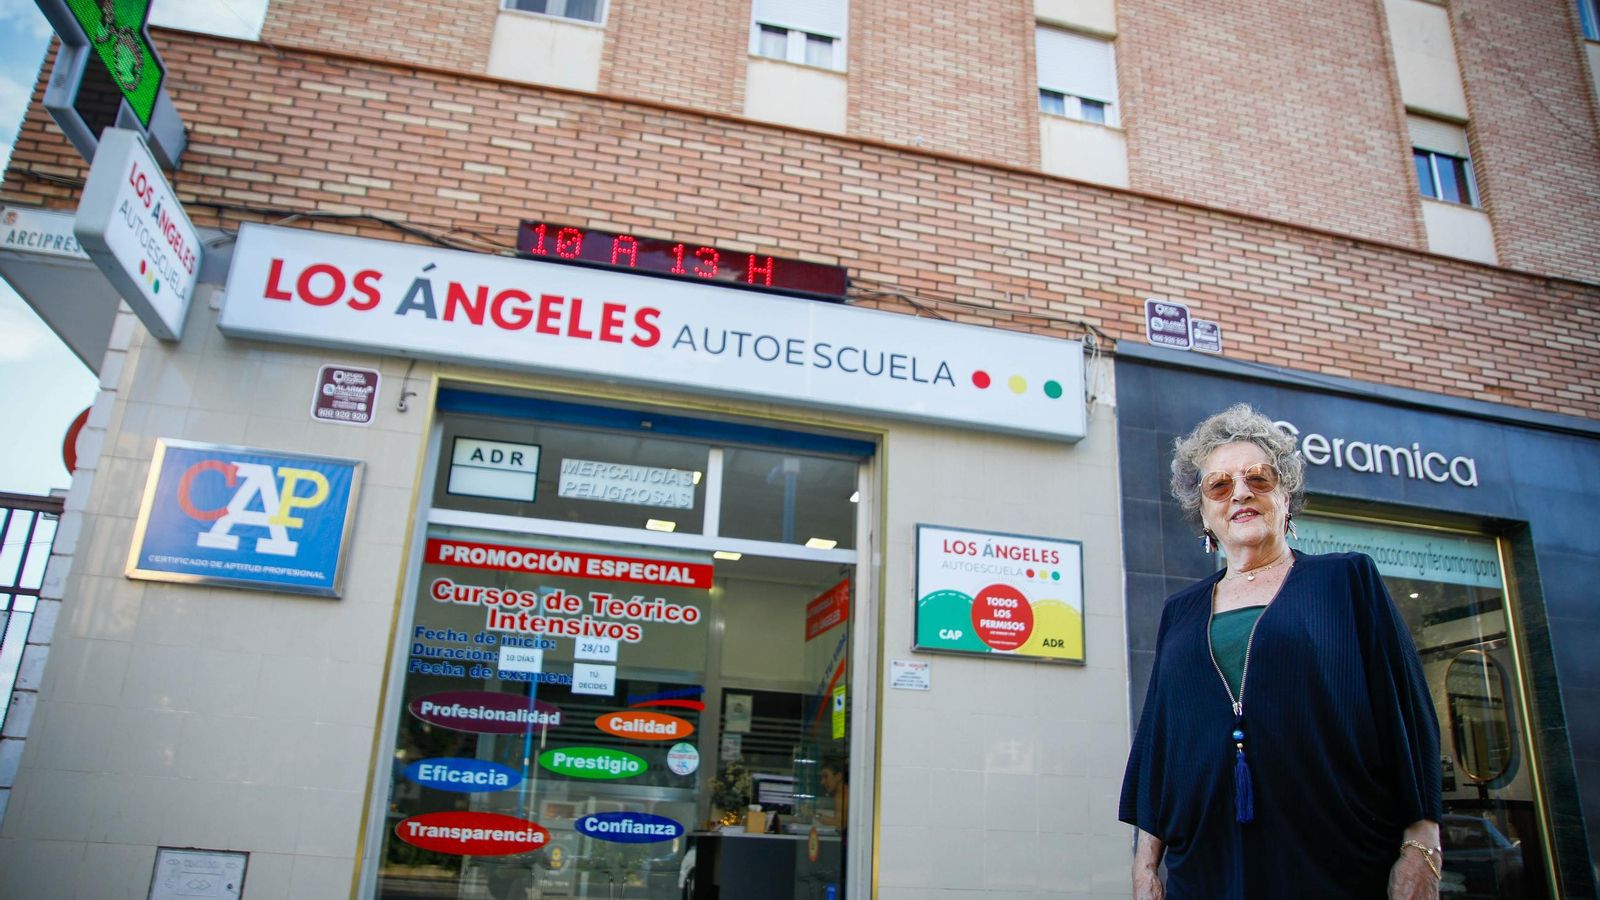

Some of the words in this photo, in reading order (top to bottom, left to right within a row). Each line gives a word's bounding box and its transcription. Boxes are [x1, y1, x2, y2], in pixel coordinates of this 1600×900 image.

[129, 162, 154, 208] LOS
[151, 196, 196, 275] ÁNGELES
[119, 200, 187, 300] AUTOESCUELA
[532, 223, 582, 259] 10
[611, 235, 637, 268] A
[671, 243, 719, 278] 13
[747, 254, 773, 287] H
[263, 258, 383, 311] LOS
[395, 262, 662, 348] ÁNGELES
[672, 324, 956, 387] AUTOESCUELA
[470, 448, 524, 466] ADR
[562, 459, 694, 487] MERCANCIAS
[562, 481, 693, 508] PELIGROSAS
[177, 460, 330, 557] CAP
[943, 538, 977, 556] LOS
[982, 538, 1060, 565] ÁNGELES
[148, 554, 209, 568] CERTIFICADO
[210, 560, 223, 569] DE
[224, 561, 261, 573] APTITUD
[262, 566, 326, 580] PROFESIONAL
[439, 543, 580, 574] PROMOCIÓN
[586, 558, 695, 584] ESPECIAL
[941, 560, 1024, 577] AUTOESCUELA
[431, 578, 536, 608] Cursos
[545, 588, 580, 613] de
[588, 592, 700, 624] Teórico
[986, 597, 1018, 608] TODOS
[486, 607, 642, 642] Intensivos
[993, 608, 1012, 619] LOS
[938, 629, 963, 640] CAP
[980, 619, 1025, 631] PERMISOS
[414, 625, 467, 644] Fecha
[474, 629, 496, 645] de
[501, 631, 556, 650] inicio:
[1042, 638, 1065, 649] ADR
[412, 642, 500, 662] Duración:
[505, 653, 515, 662] 10
[581, 643, 610, 655] 28/10
[409, 660, 464, 678] Fecha
[470, 661, 492, 678] de
[577, 681, 608, 691] DECIDES
[420, 701, 561, 725] Profesionalidad
[609, 716, 677, 735] Calidad
[553, 752, 639, 774] Prestigio
[418, 764, 509, 786] Eficacia
[407, 821, 544, 844] Transparencia
[584, 817, 676, 836] Confianza
